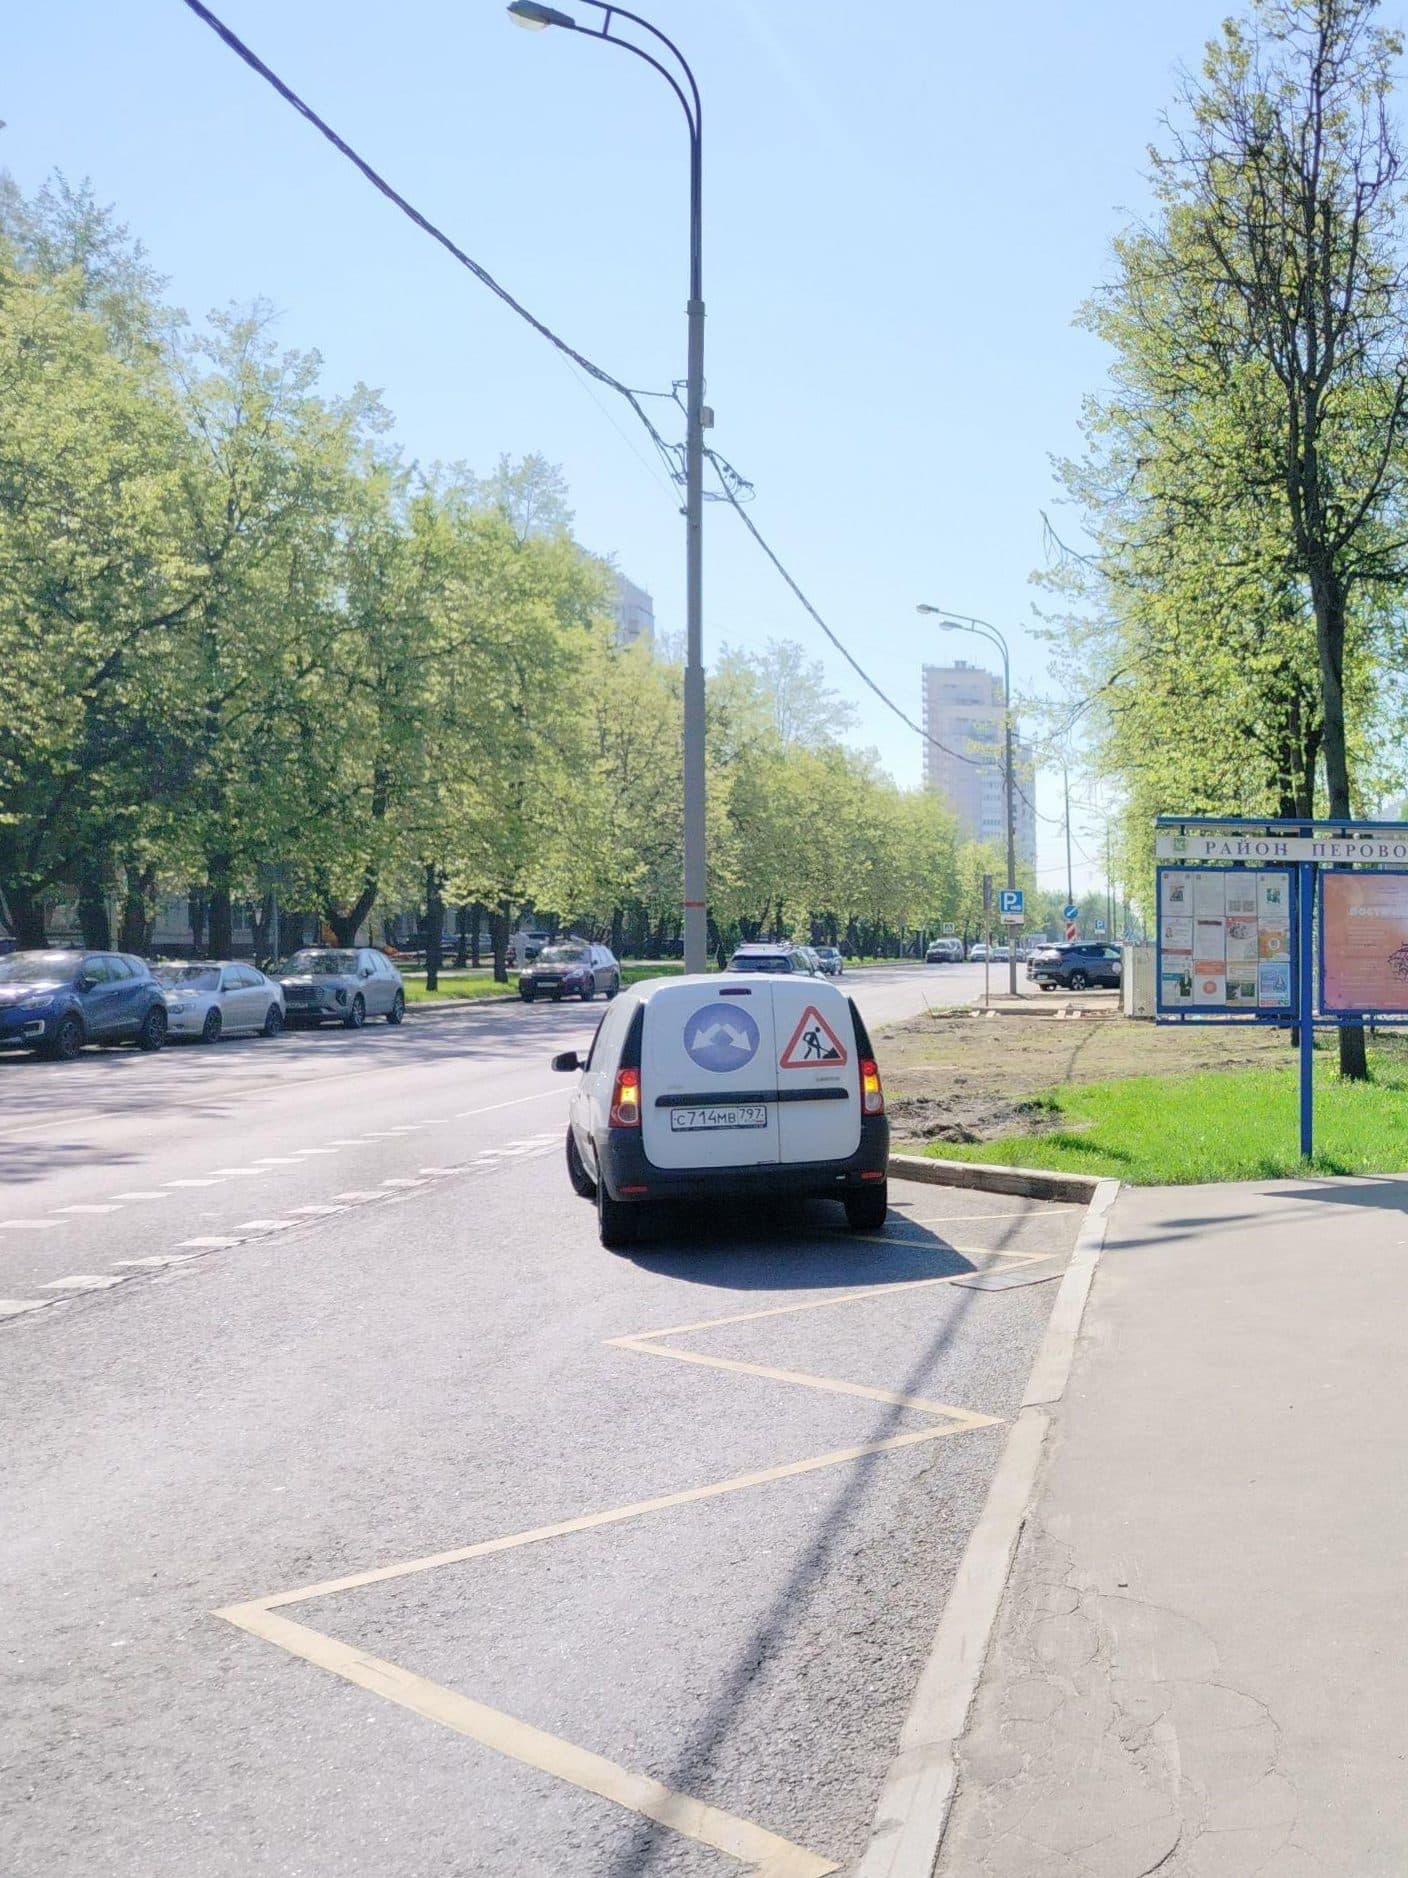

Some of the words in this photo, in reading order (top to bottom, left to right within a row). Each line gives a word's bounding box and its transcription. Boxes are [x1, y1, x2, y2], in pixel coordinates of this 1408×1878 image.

[1205, 839, 1288, 856] РАЙОН
[1312, 843, 1408, 859] ПЕРОВО
[739, 1108, 761, 1120] 797
